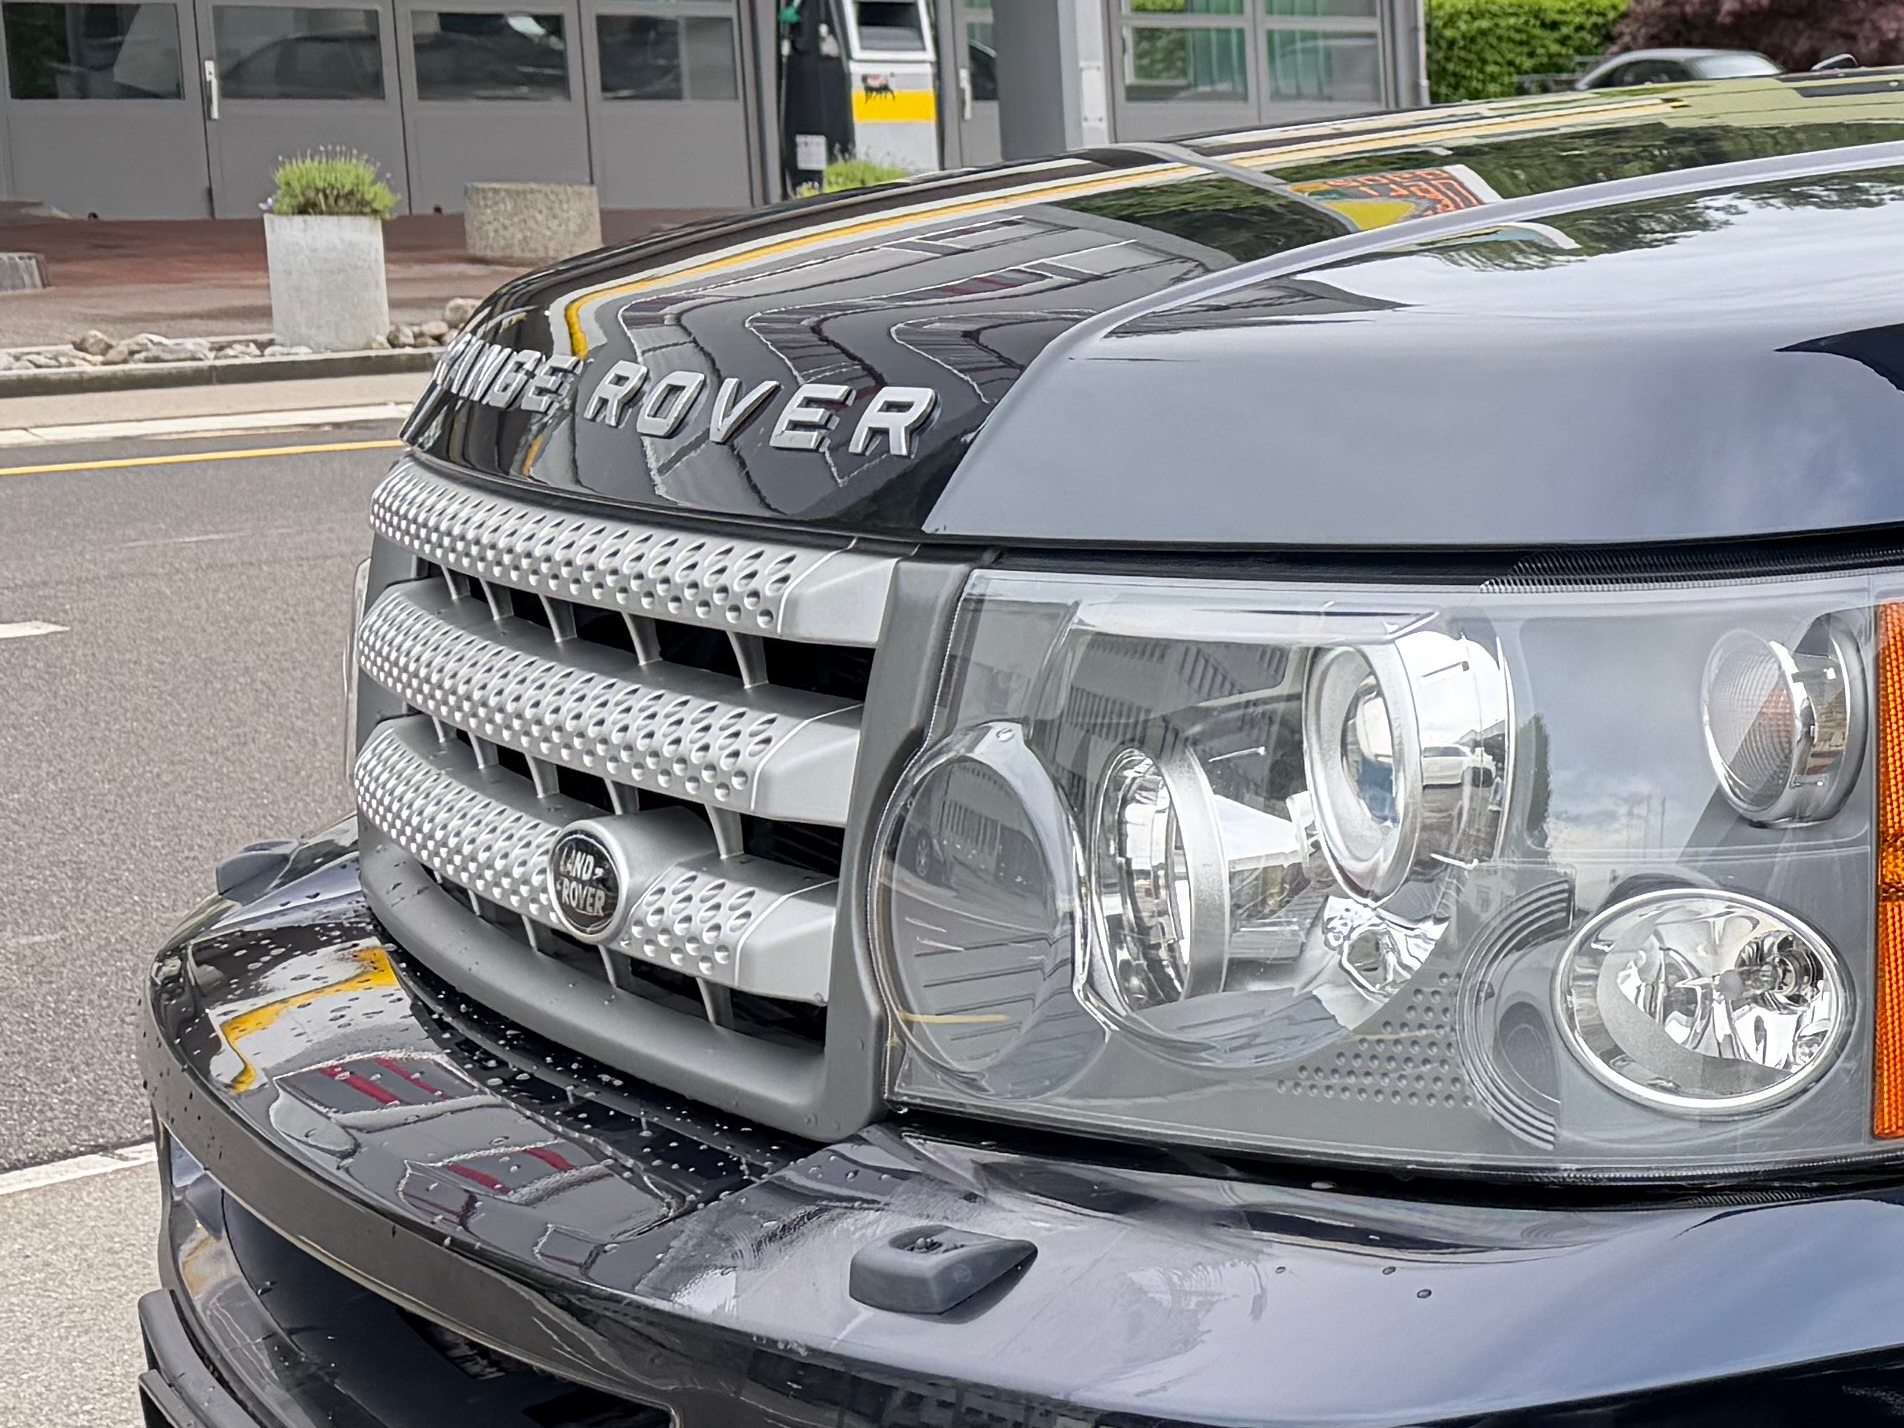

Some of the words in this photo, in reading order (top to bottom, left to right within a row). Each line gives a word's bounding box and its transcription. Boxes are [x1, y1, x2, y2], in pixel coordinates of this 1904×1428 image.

[583, 358, 938, 458] ROVER
[560, 844, 595, 880] LAND
[562, 878, 605, 916] ROVER
